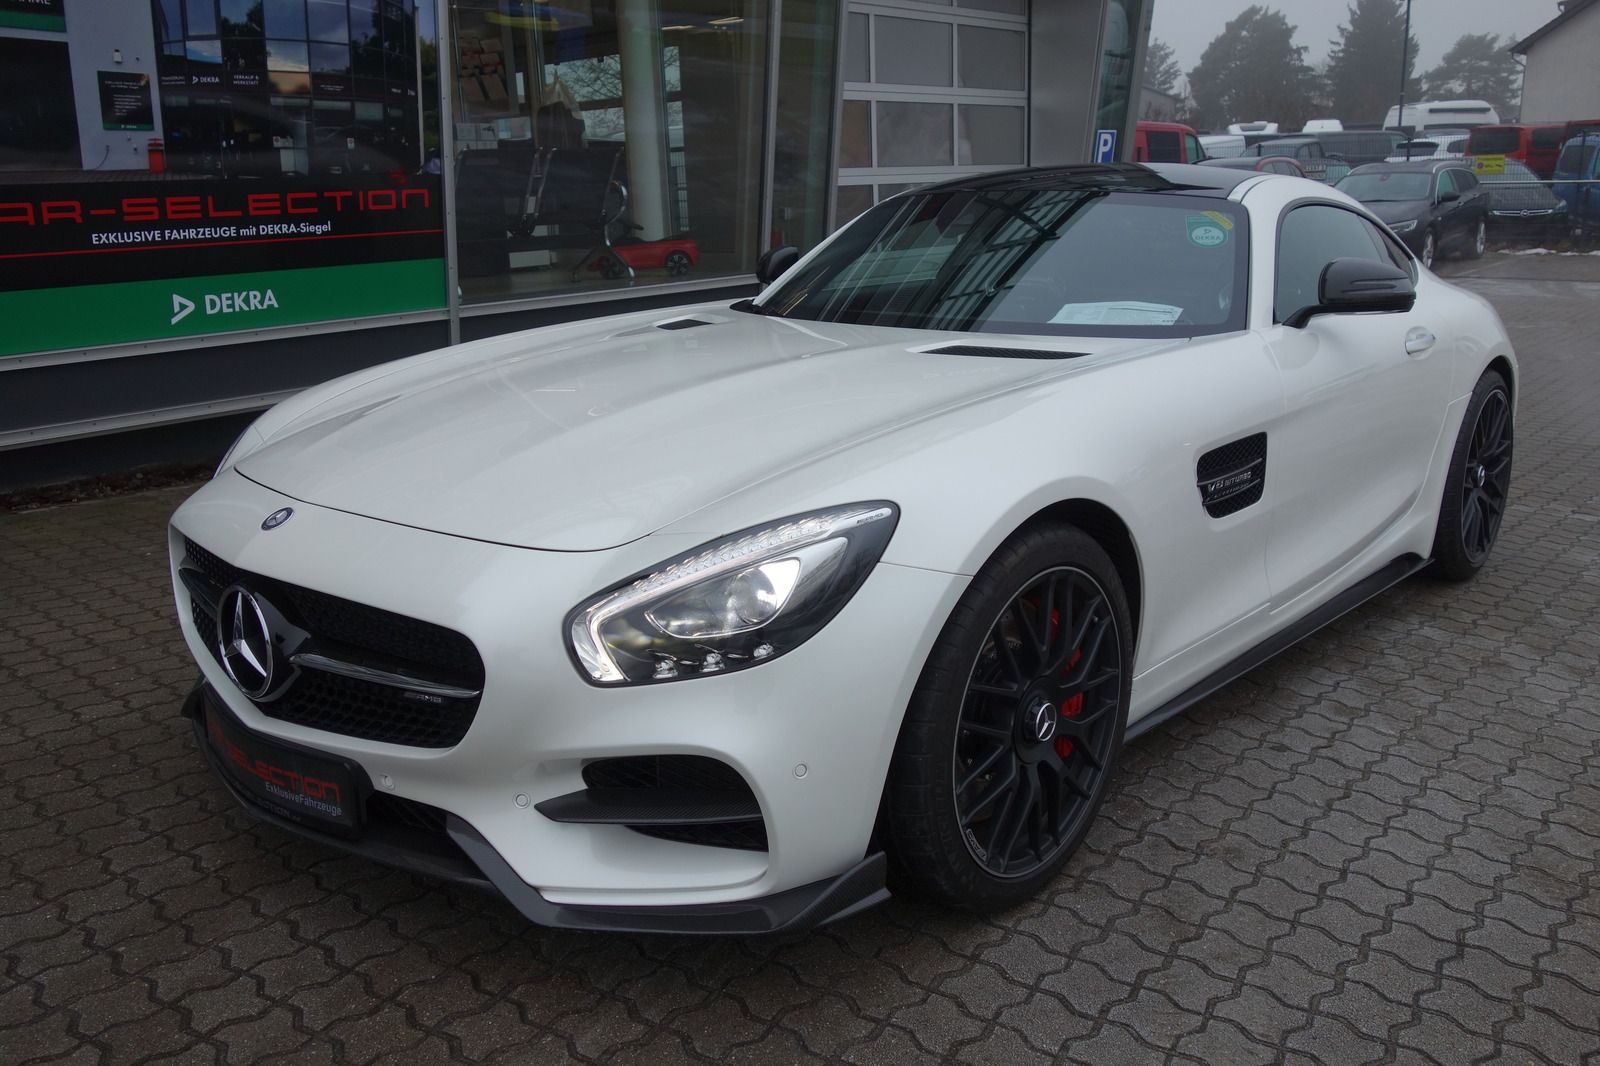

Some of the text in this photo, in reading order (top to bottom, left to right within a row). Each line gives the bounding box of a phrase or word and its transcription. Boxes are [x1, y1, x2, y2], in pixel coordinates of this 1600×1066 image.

[1098, 133, 1112, 163] P
[92, 221, 332, 244] EXKLUSIVE FAHRZEUGE mit DEKRA-Siegel
[204, 289, 279, 314] DEKRA
